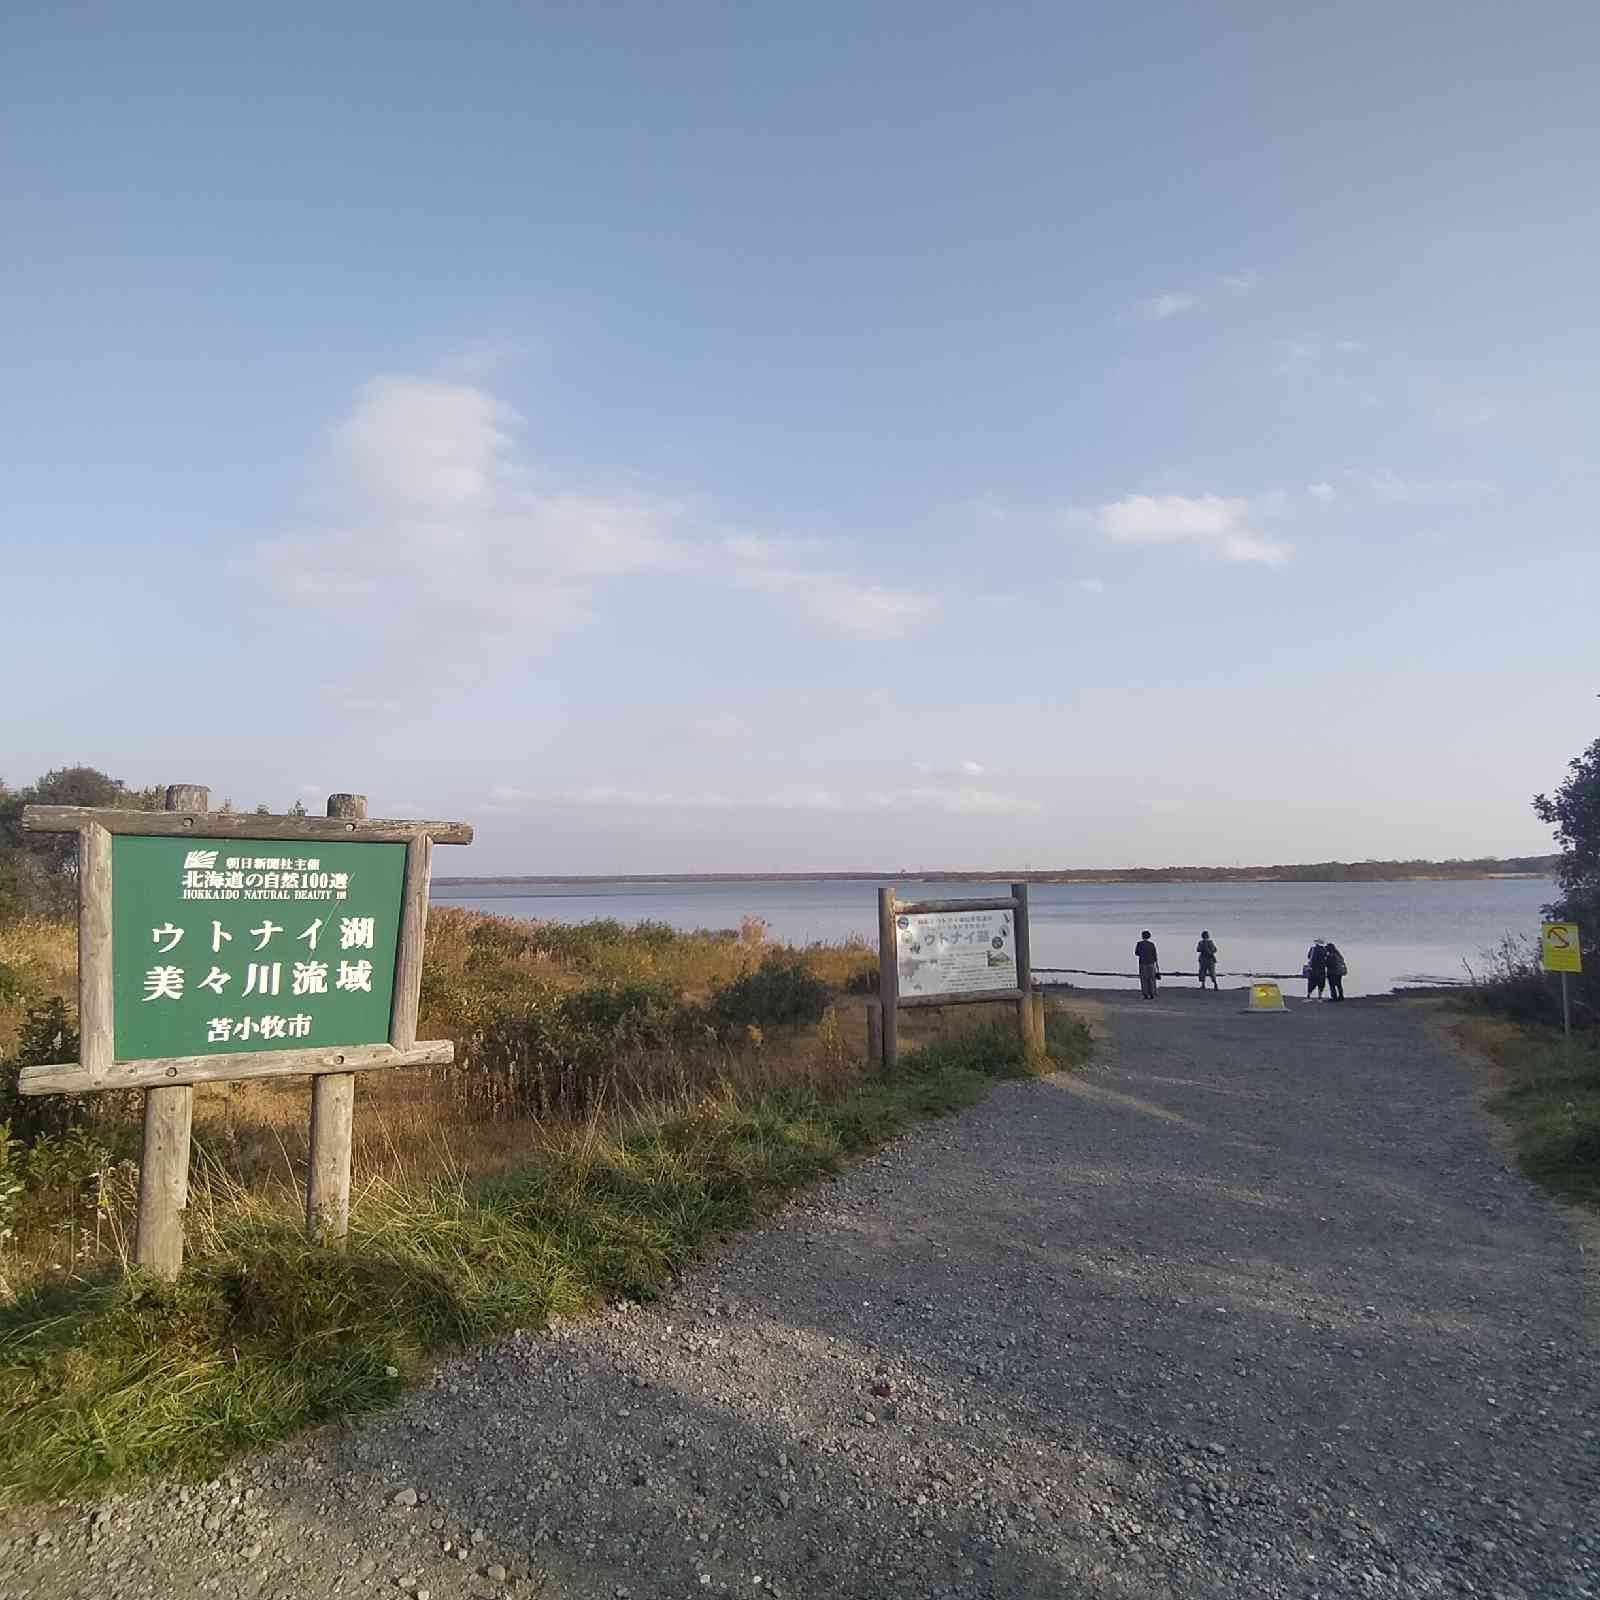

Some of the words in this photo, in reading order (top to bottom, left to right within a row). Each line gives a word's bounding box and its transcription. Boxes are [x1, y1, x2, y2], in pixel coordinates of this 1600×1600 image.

[181, 871, 349, 889] 北海道の自然100選
[183, 889, 240, 900] HOKKAIDO
[243, 889, 290, 900] NATURAL
[294, 889, 332, 900] BEAUTY
[151, 917, 374, 953] ウトナイ湖
[142, 960, 373, 1002] 美々川流域
[206, 1013, 313, 1042] 苫小牧市
